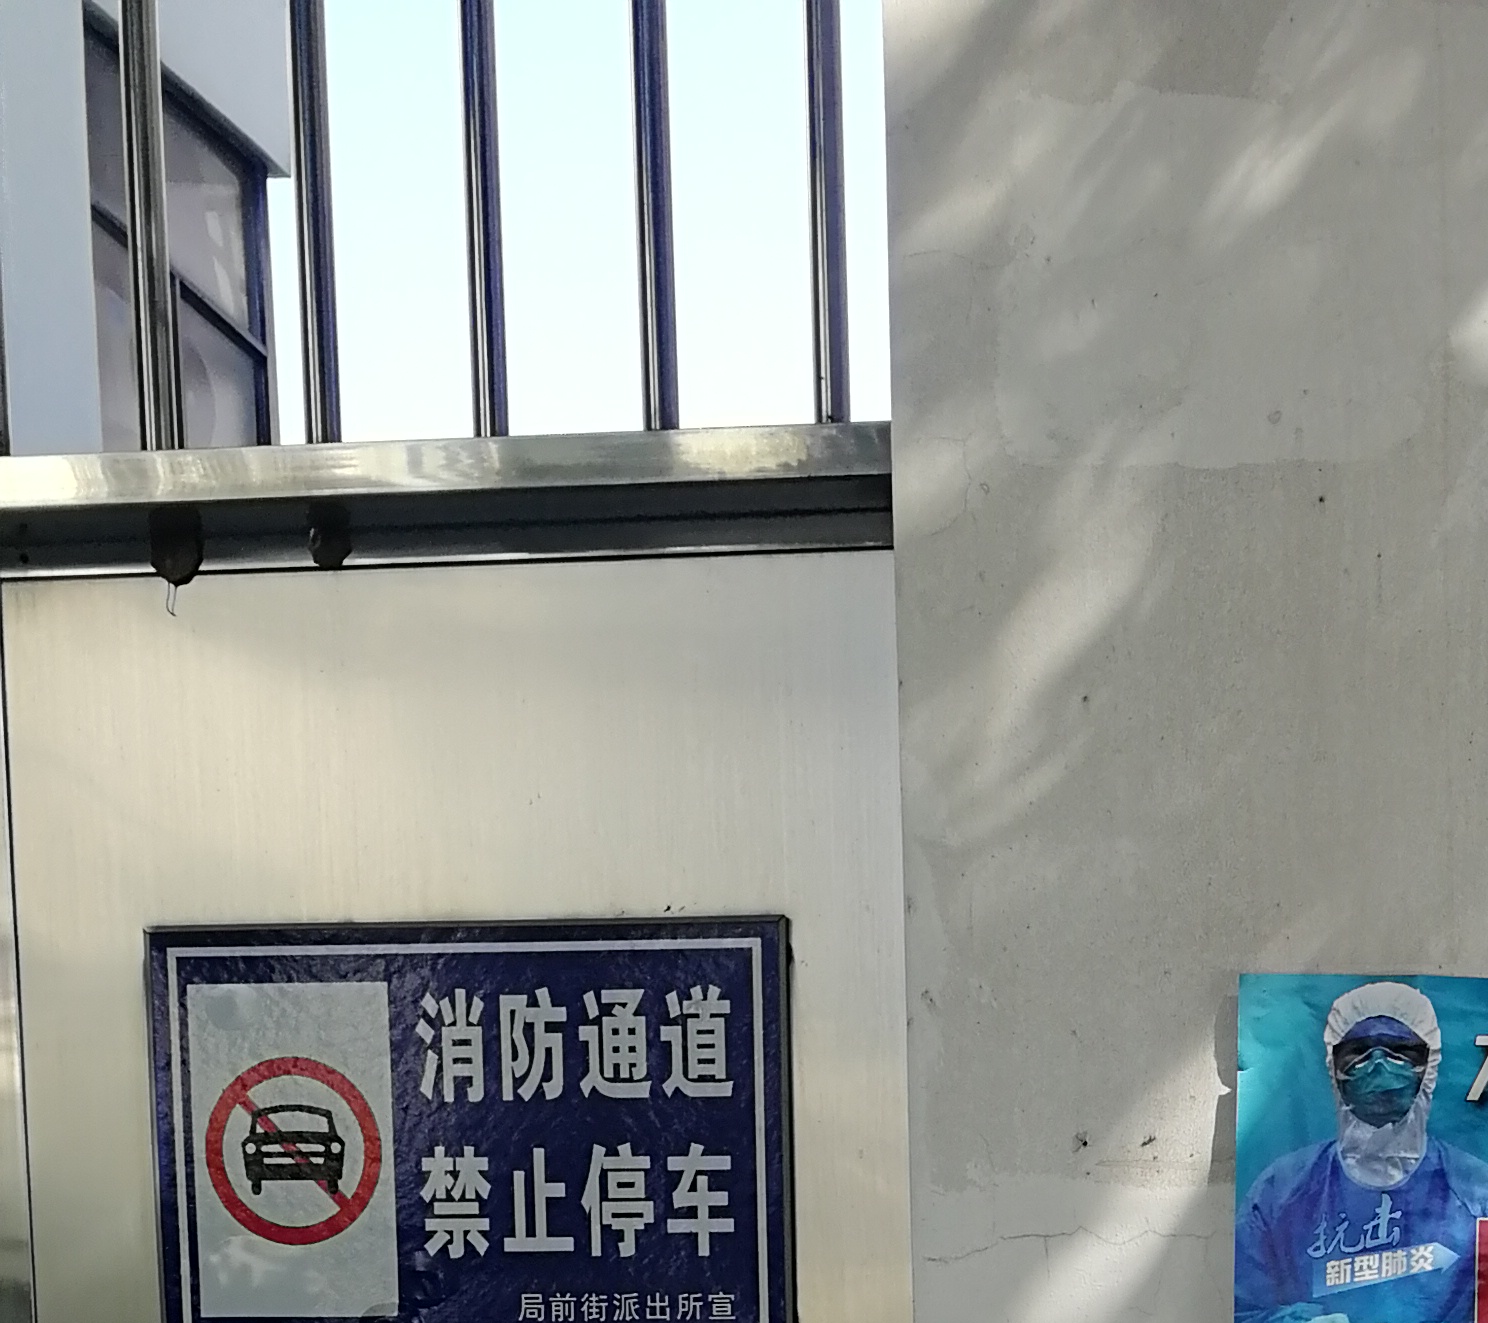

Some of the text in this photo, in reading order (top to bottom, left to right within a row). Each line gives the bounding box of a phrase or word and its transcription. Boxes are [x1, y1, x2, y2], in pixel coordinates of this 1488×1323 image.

[415, 984, 734, 1102] 消防通道
[419, 1143, 735, 1258] 禁止停车
[1306, 1193, 1402, 1258] 抗击
[1325, 1245, 1434, 1287] 新型肺炎
[518, 1293, 736, 1323] 局前街派出所宣
